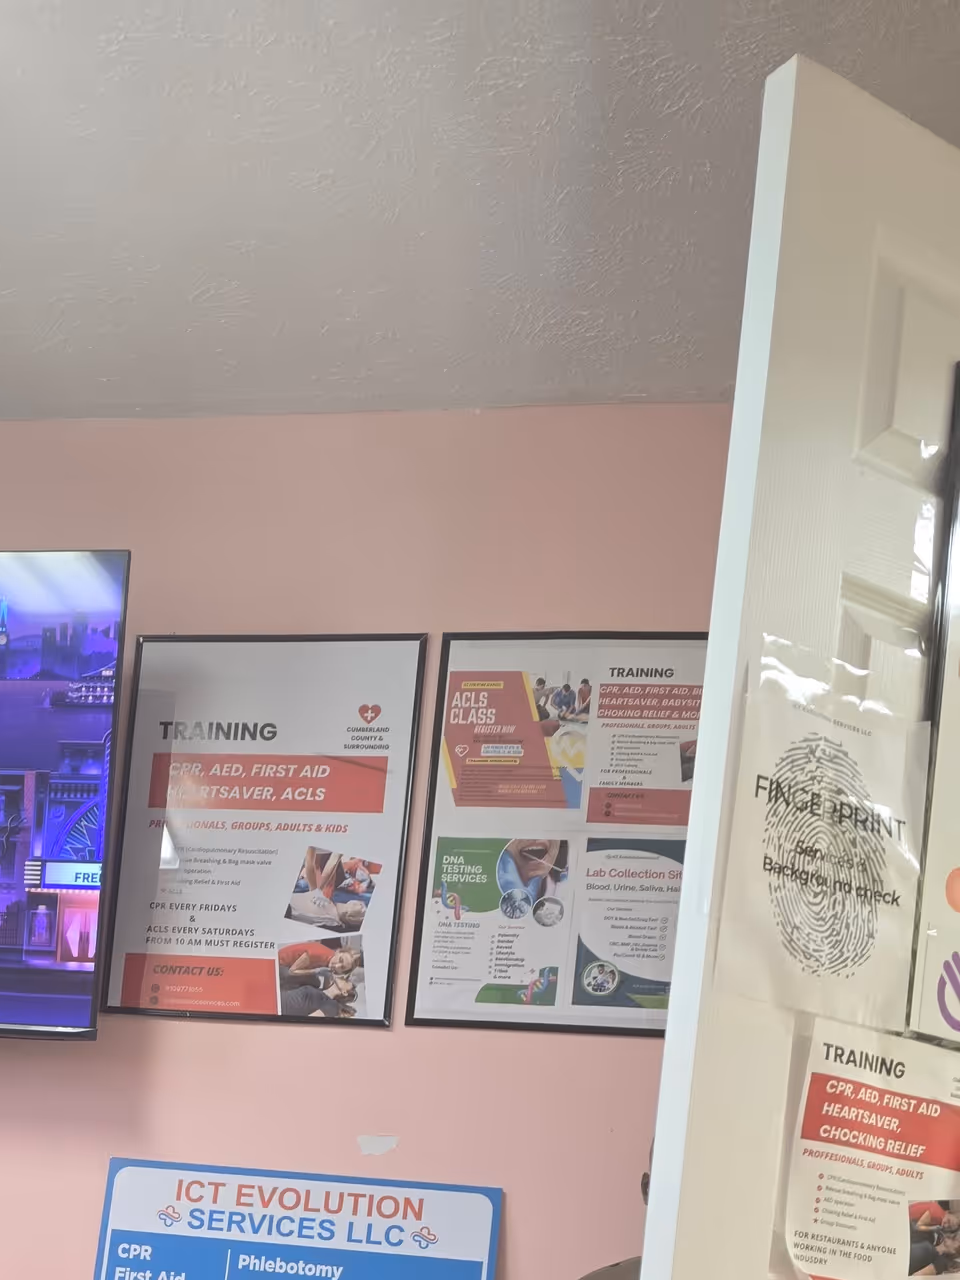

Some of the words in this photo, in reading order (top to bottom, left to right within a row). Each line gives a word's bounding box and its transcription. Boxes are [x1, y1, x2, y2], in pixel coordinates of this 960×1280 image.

[609, 667, 674, 678] TRAINING
[599, 686, 619, 694] CPR,
[623, 686, 643, 695] AED,
[645, 686, 670, 694] FIRST
[672, 688, 691, 696] AID,
[452, 692, 488, 707] ACLS
[598, 698, 660, 707] HEARTSAVER,
[450, 708, 496, 724] CLASS
[598, 709, 641, 717] CHOKING
[642, 710, 671, 718] RELIEF
[160, 721, 278, 741] TRAINING
[169, 762, 206, 778] CPR,
[209, 763, 245, 778] AED,
[251, 764, 296, 778] FIRST
[300, 765, 330, 778] AID
[280, 787, 326, 801] ACLS
[231, 821, 272, 832] GROUPS,
[275, 822, 313, 832] ADULTS
[315, 823, 323, 832] &
[324, 823, 348, 833] KIDS
[443, 855, 465, 865] DNA
[442, 864, 482, 874] TESTING
[586, 868, 606, 878] Lab
[609, 868, 665, 879] Collection
[441, 873, 487, 883] SERVICES
[763, 856, 852, 894] Background
[855, 885, 901, 906] check
[149, 902, 167, 910] CPR
[169, 903, 197, 911] EVERY
[199, 903, 237, 912] FRIDAYS
[146, 925, 169, 934] ACLS
[171, 926, 199, 935] EVERY
[201, 927, 255, 936] SATURDAYS
[438, 921, 452, 929] DNA
[145, 936, 173, 945] FROM
[175, 938, 185, 946] 10
[187, 938, 202, 946] AM
[204, 938, 230, 948] MUST
[232, 939, 275, 949] REGISTER
[153, 965, 205, 976] CONTACT
[207, 967, 224, 976] US:
[823, 1043, 906, 1079] TRAINING
[826, 1080, 857, 1099] CPR,
[857, 1087, 881, 1106] AED,
[883, 1095, 917, 1112] FIRST
[917, 1102, 940, 1117] AID
[822, 1102, 902, 1133] HEARTSAVER,
[819, 1125, 885, 1150] CHOCKING
[886, 1139, 926, 1158] RELIEF
[867, 1161, 894, 1175] GROUPS,
[895, 1167, 924, 1180] ADULTS
[175, 1178, 225, 1205] ICT
[235, 1183, 425, 1222] EVOLUTION
[187, 1207, 337, 1242] SERVICES
[346, 1220, 405, 1248] LLC
[794, 1230, 809, 1239] FOR
[811, 1233, 859, 1249] RESTAURANTS
[860, 1242, 865, 1250] &
[866, 1243, 897, 1255] ANYONE
[117, 1242, 152, 1261] CPR
[793, 1242, 827, 1255] WORKING
[840, 1250, 852, 1258] THE
[853, 1252, 873, 1262] FOOD
